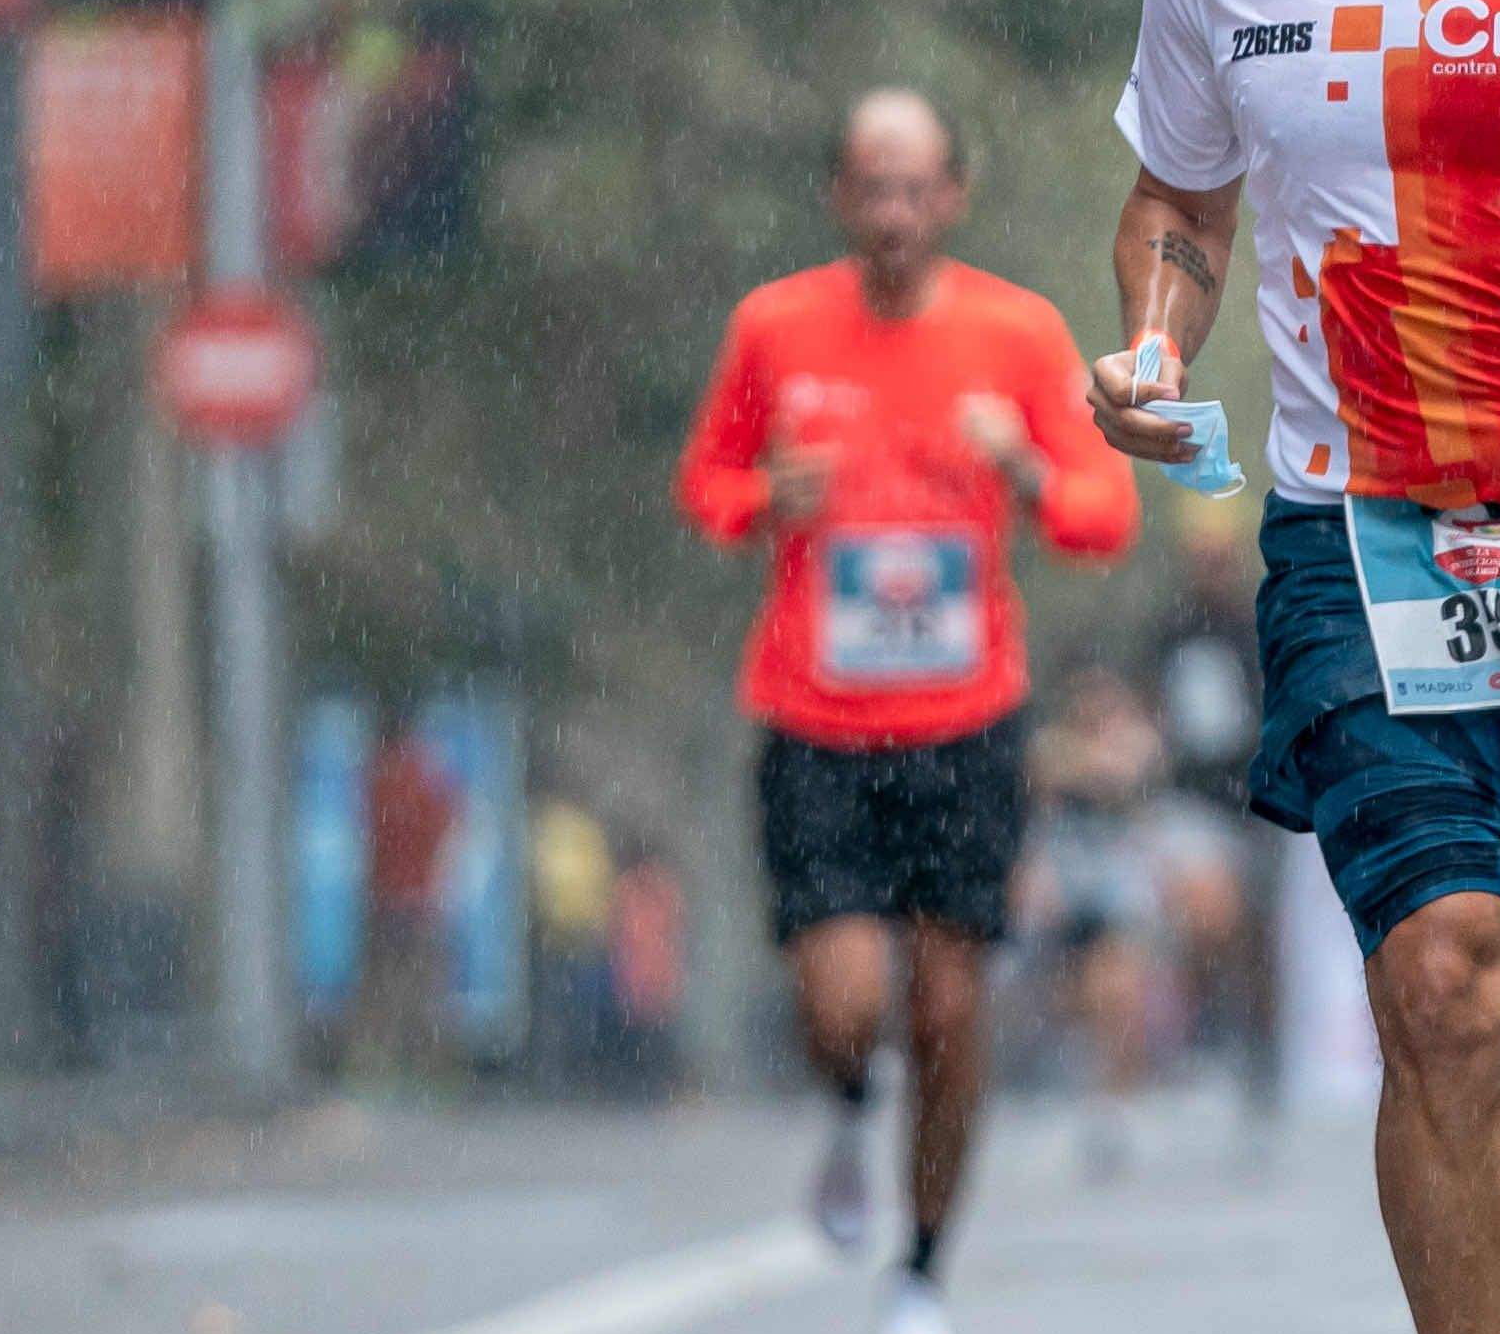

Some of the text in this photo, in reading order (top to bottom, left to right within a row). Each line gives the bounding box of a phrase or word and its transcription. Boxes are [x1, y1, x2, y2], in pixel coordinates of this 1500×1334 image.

[1231, 21, 1315, 62] 226ERS
[1432, 62, 1496, 75] contra
[1414, 681, 1474, 694] MADRID
